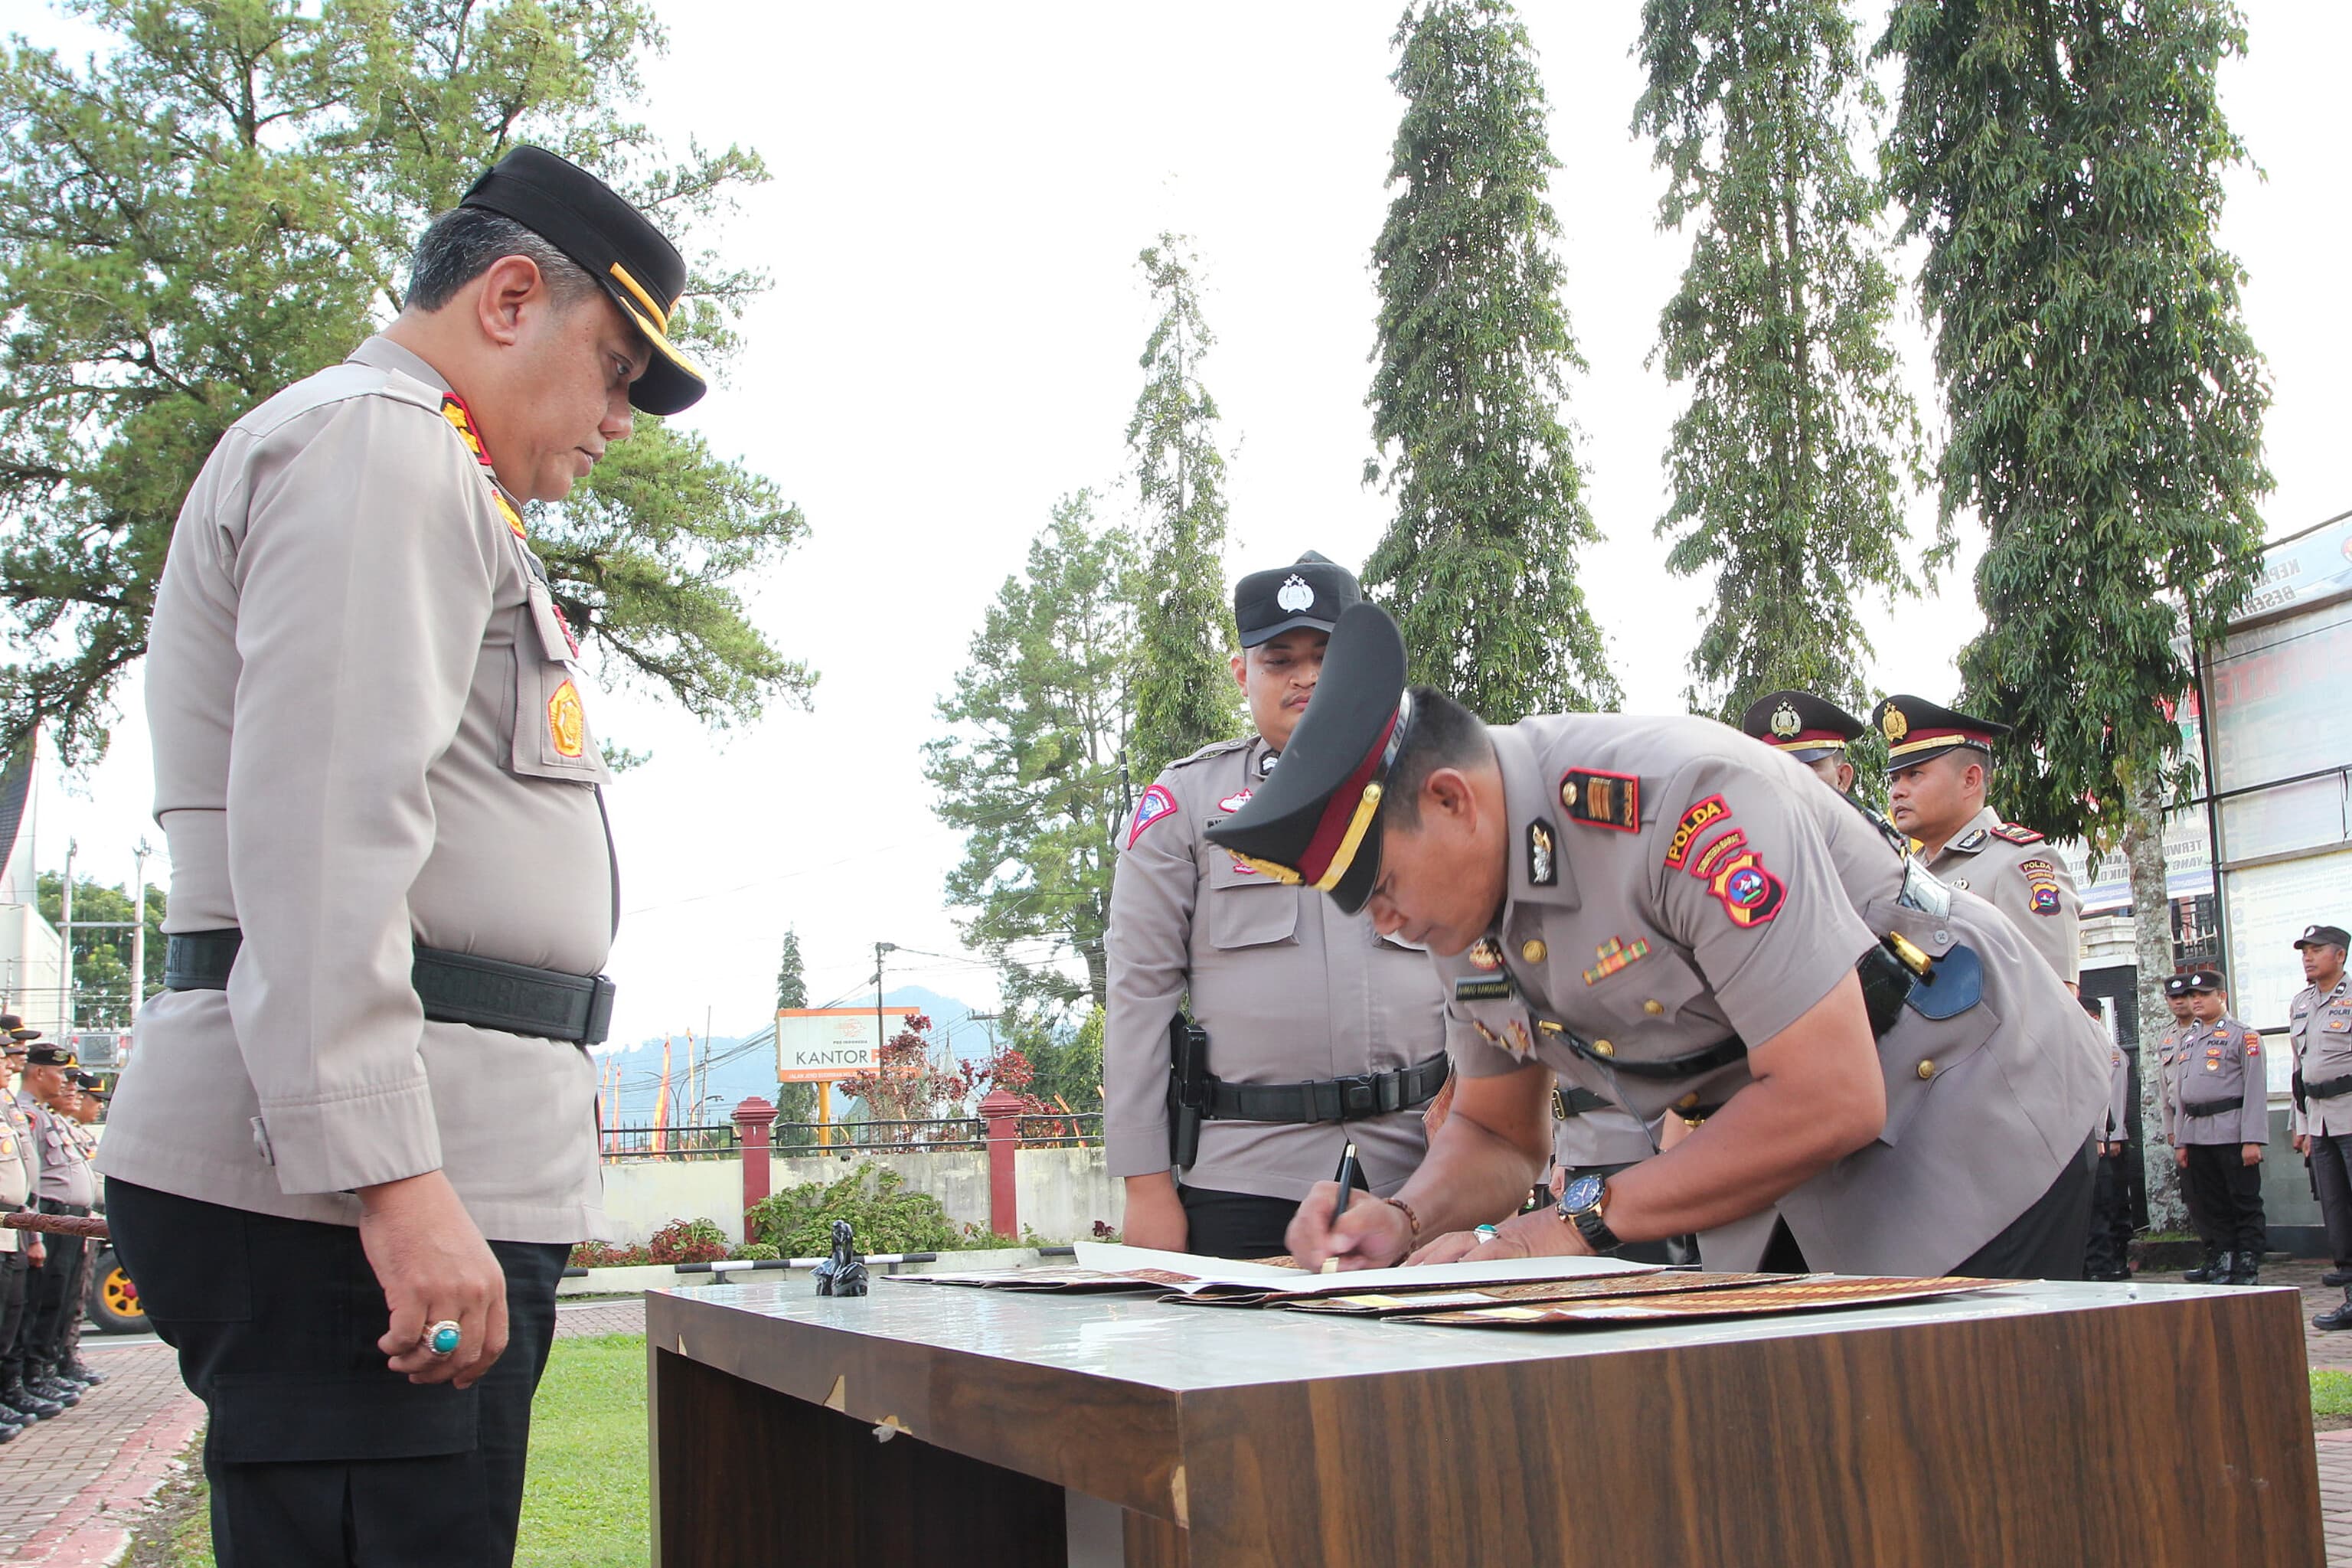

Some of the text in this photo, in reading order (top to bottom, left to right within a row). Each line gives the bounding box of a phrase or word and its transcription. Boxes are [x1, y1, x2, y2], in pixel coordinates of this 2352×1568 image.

[1668, 802, 1722, 861] POLDA
[2023, 861, 2052, 871] POLDA
[796, 1049, 868, 1065] KANTOR
